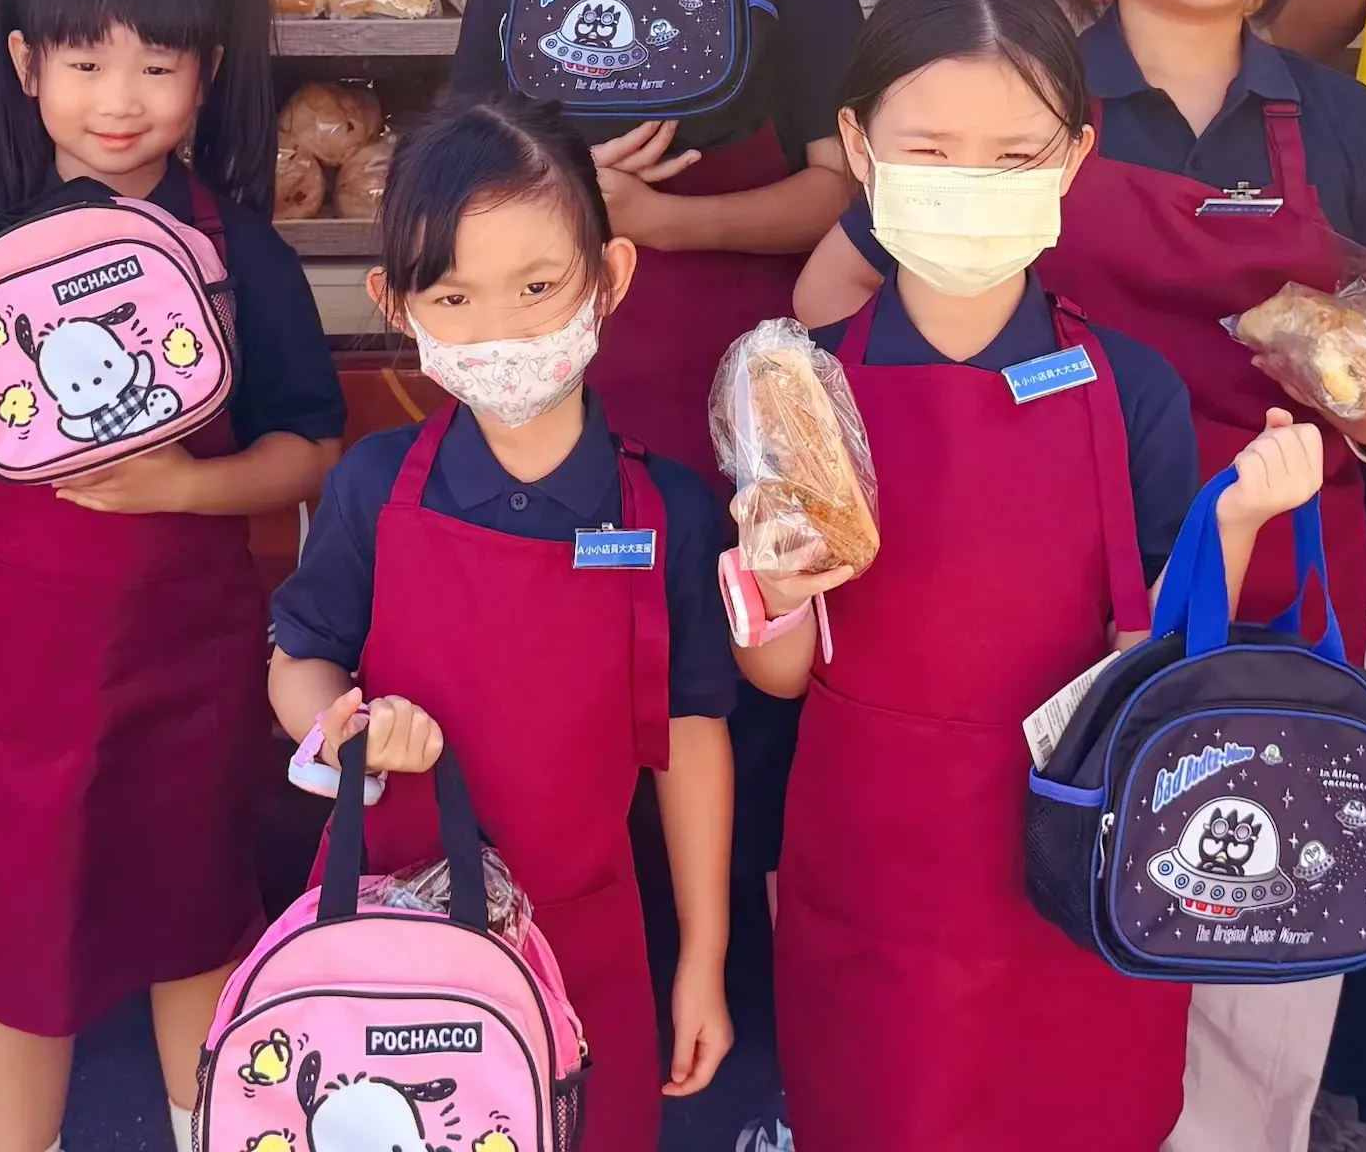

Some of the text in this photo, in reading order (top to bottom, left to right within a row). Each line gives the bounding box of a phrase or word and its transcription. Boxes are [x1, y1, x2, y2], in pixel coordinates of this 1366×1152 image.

[57, 260, 139, 301] POCHACCO
[1152, 756, 1185, 813] Bad
[1319, 768, 1360, 781] In Alien
[1195, 924, 1314, 945] The Original Space Warrior
[371, 1027, 478, 1051] POCHACCO
